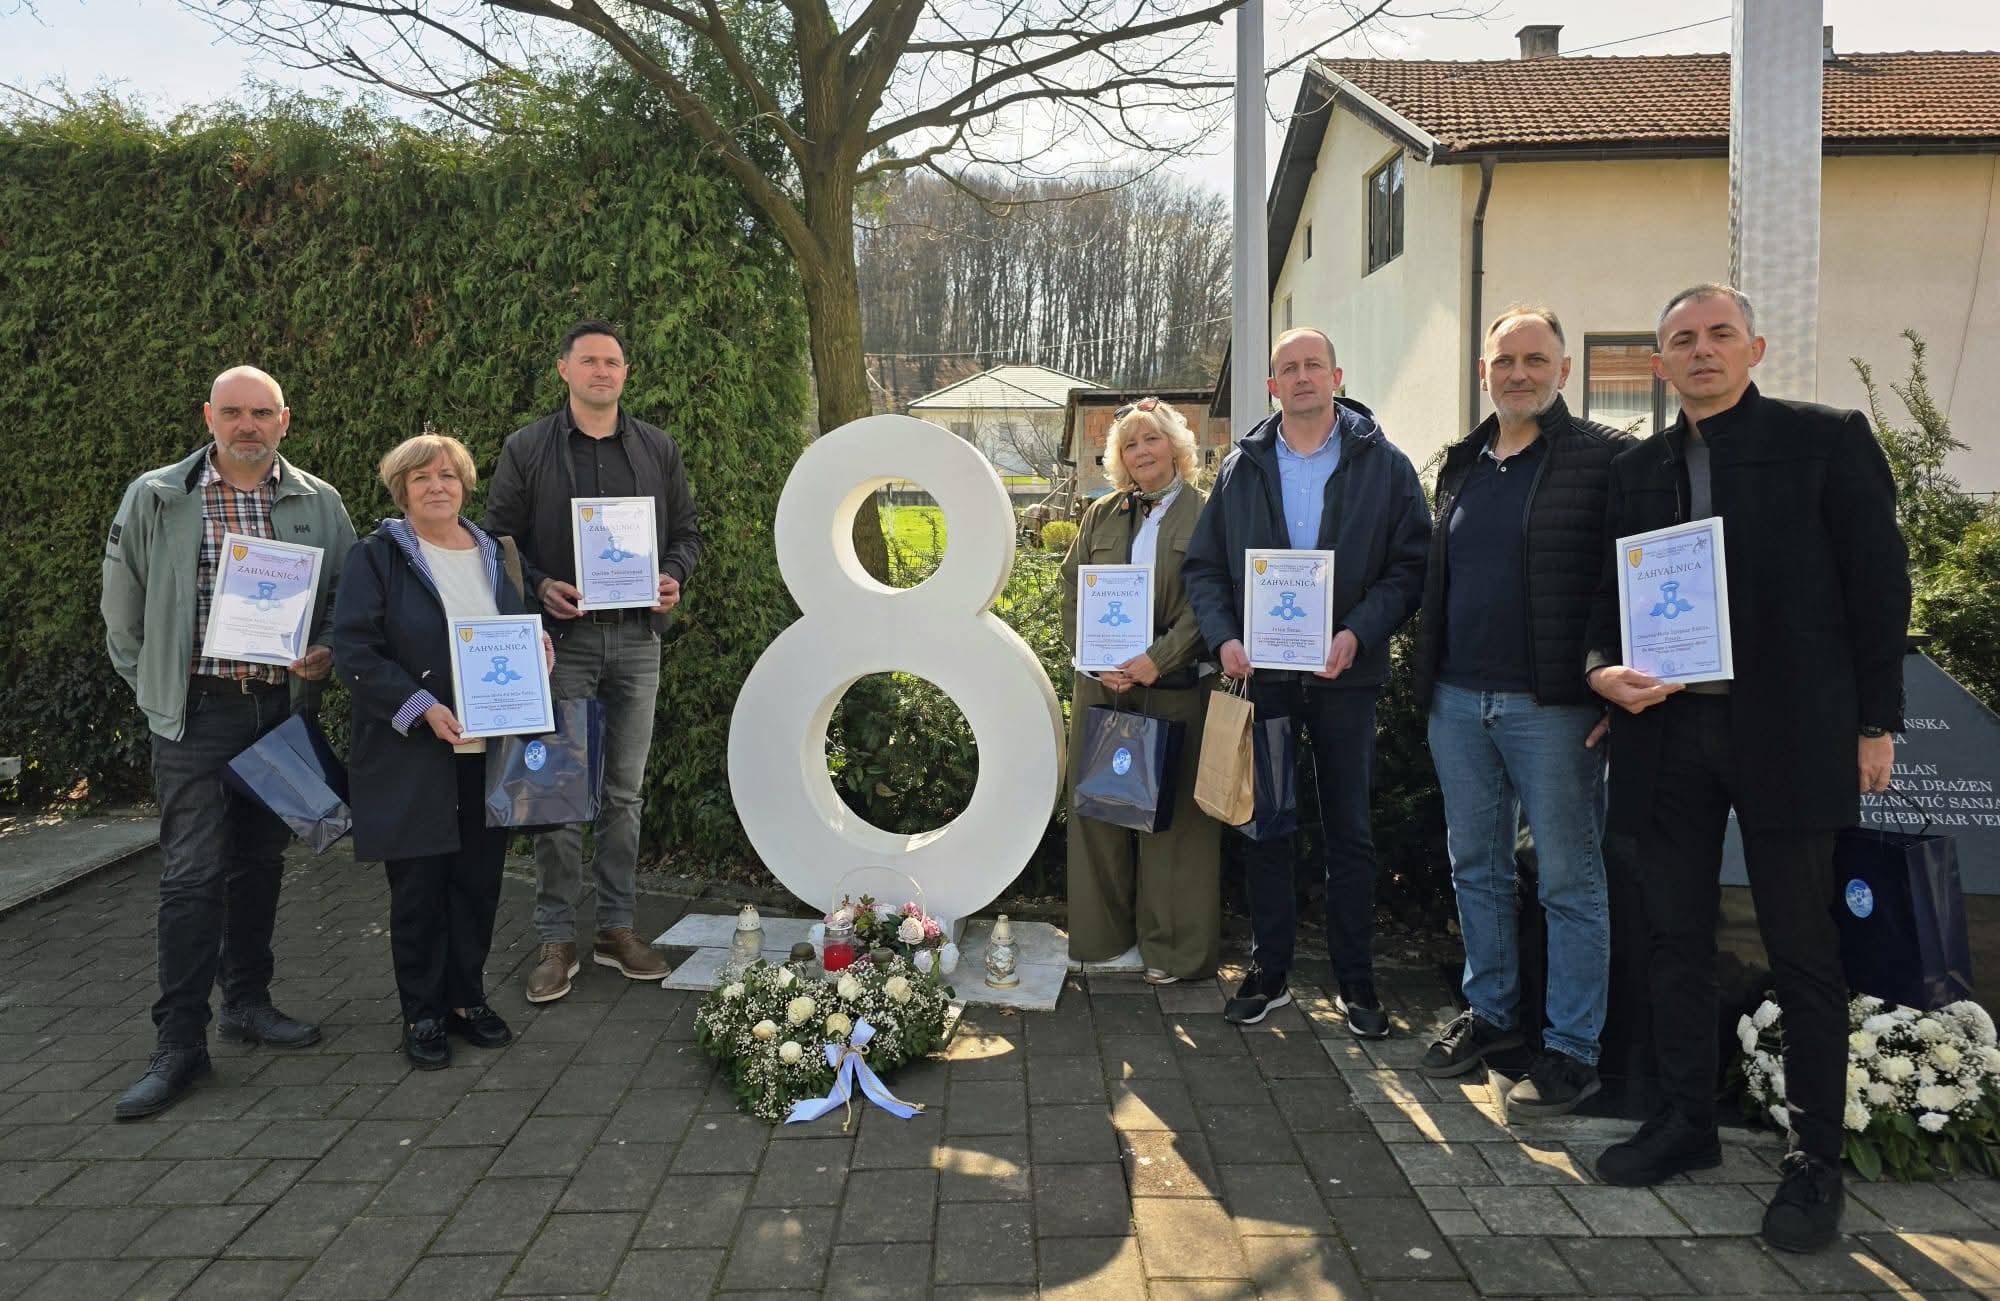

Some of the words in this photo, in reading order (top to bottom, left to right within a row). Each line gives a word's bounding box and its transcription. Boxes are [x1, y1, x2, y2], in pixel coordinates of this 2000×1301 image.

[238, 565, 300, 581] ZAHVALNICA
[1637, 561, 1702, 581] ZAHVALNICA
[1260, 579, 1316, 587] ZAHVALNICA
[468, 644, 528, 653] ZAHVALNICA
[1904, 718, 1951, 730] NSKA
[1921, 777, 1993, 792] DRAŽEN
